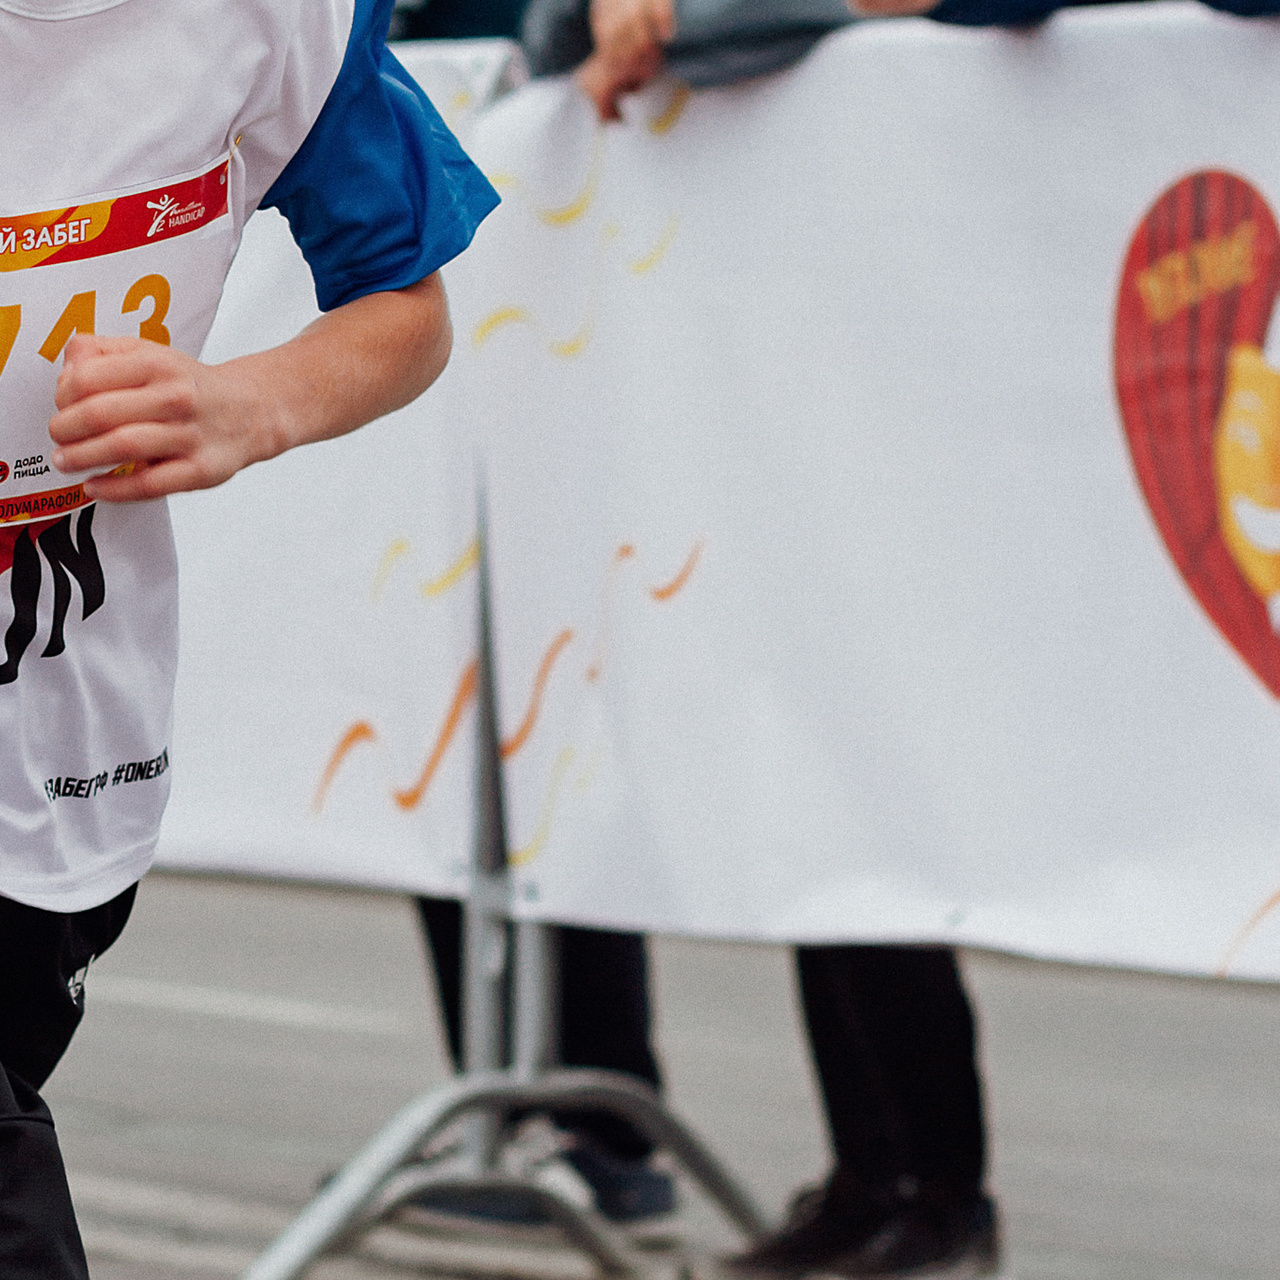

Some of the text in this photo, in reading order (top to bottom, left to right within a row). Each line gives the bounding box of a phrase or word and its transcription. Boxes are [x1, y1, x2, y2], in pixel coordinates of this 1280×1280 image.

[168, 206, 206, 228] HANDICAP
[22, 219, 91, 250] ЗАБЕГ
[14, 455, 44, 469] ДОДО
[14, 465, 50, 480] ПИЦЦА
